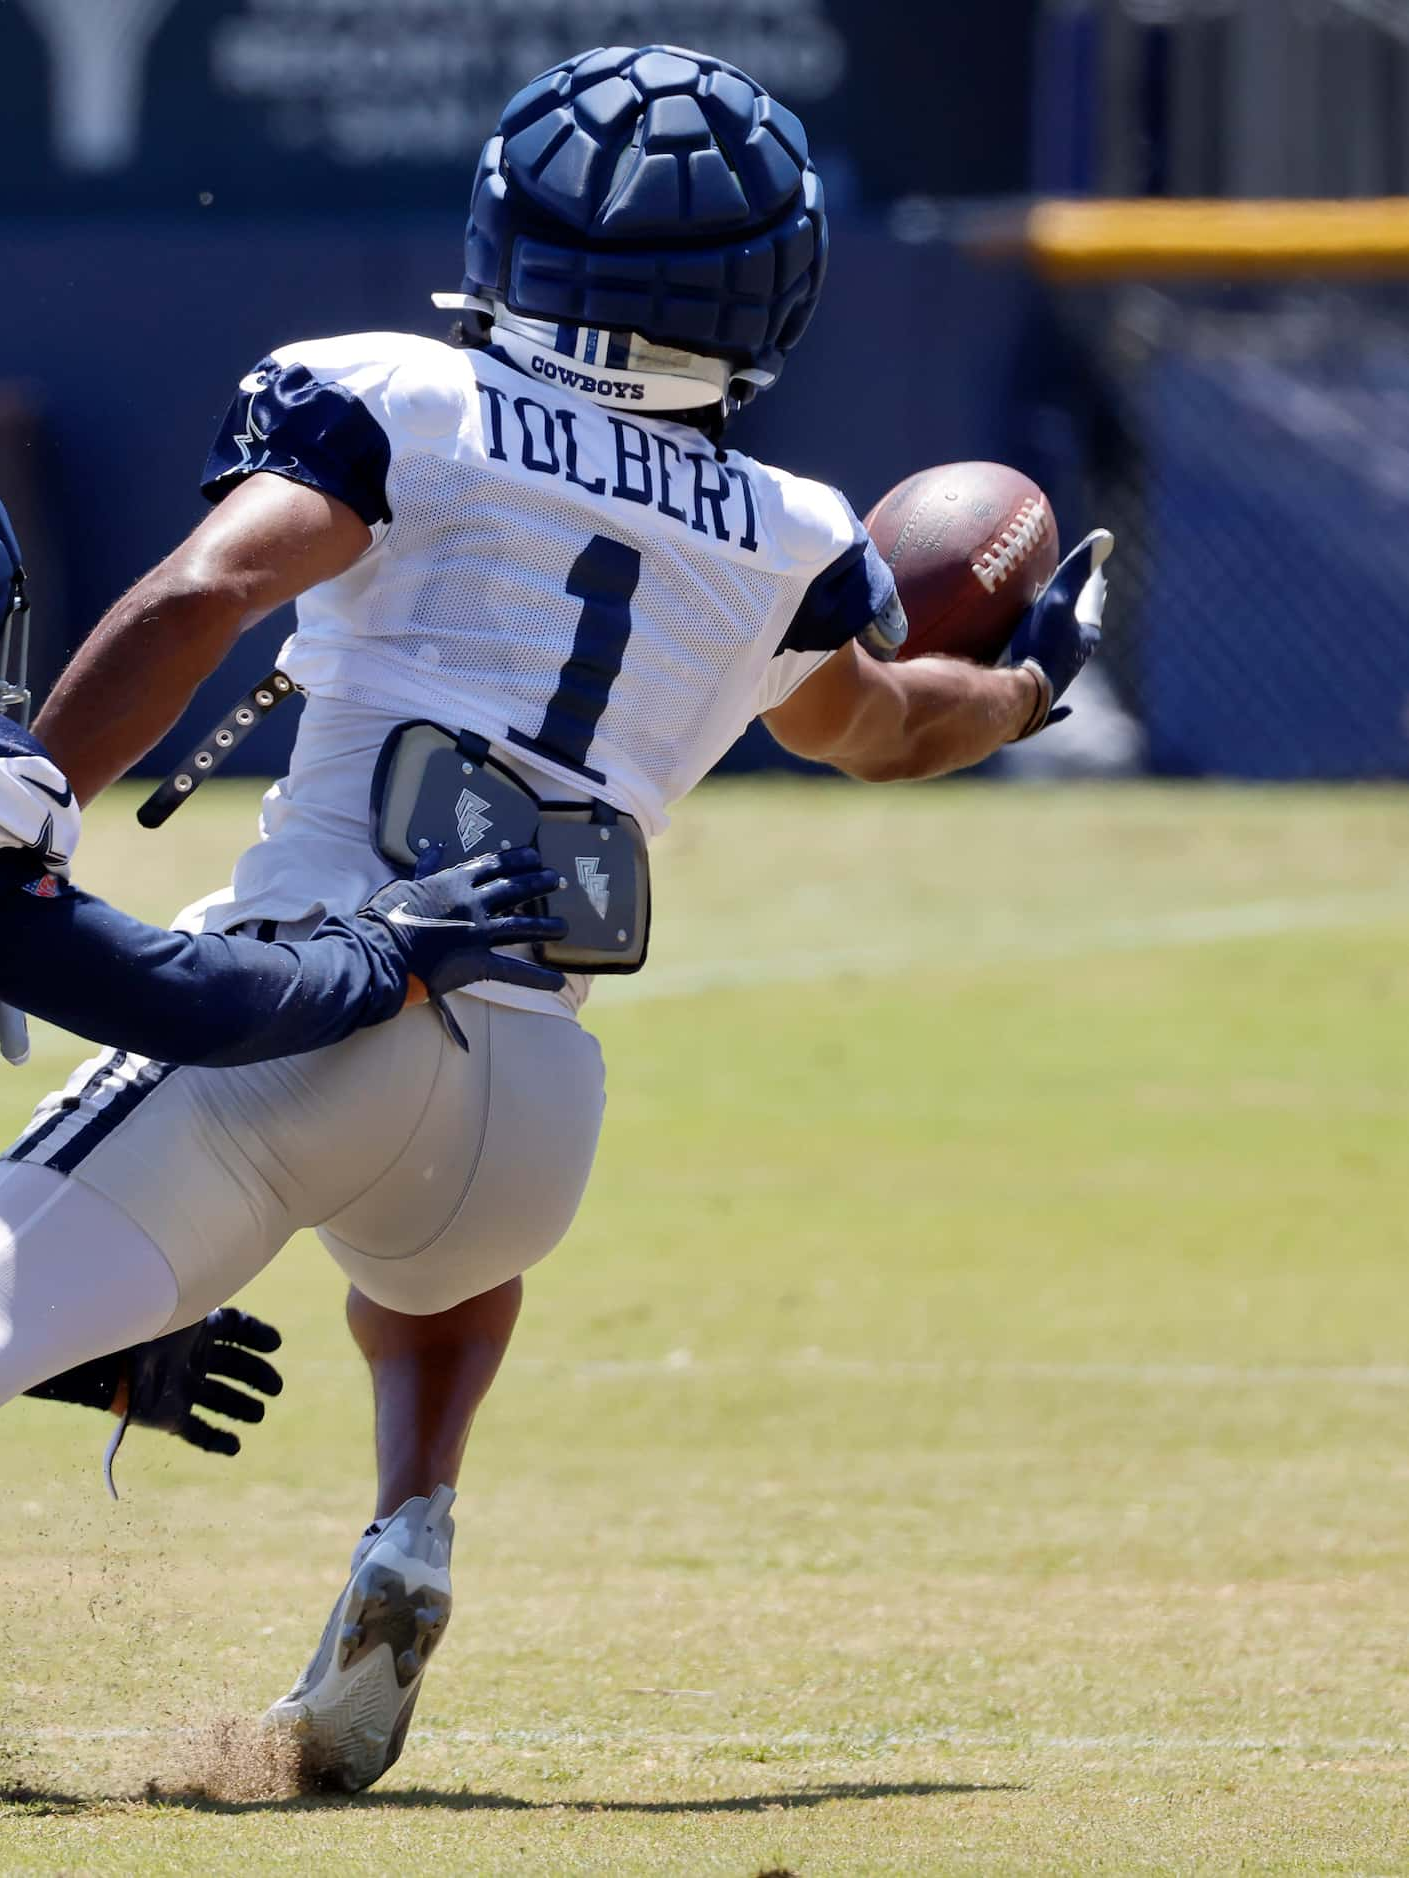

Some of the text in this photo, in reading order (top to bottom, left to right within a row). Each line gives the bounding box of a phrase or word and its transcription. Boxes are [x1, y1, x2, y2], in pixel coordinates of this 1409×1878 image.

[530, 354, 645, 400] COWBOYS
[476, 380, 759, 553] TOLBERT
[506, 534, 642, 785] 1
